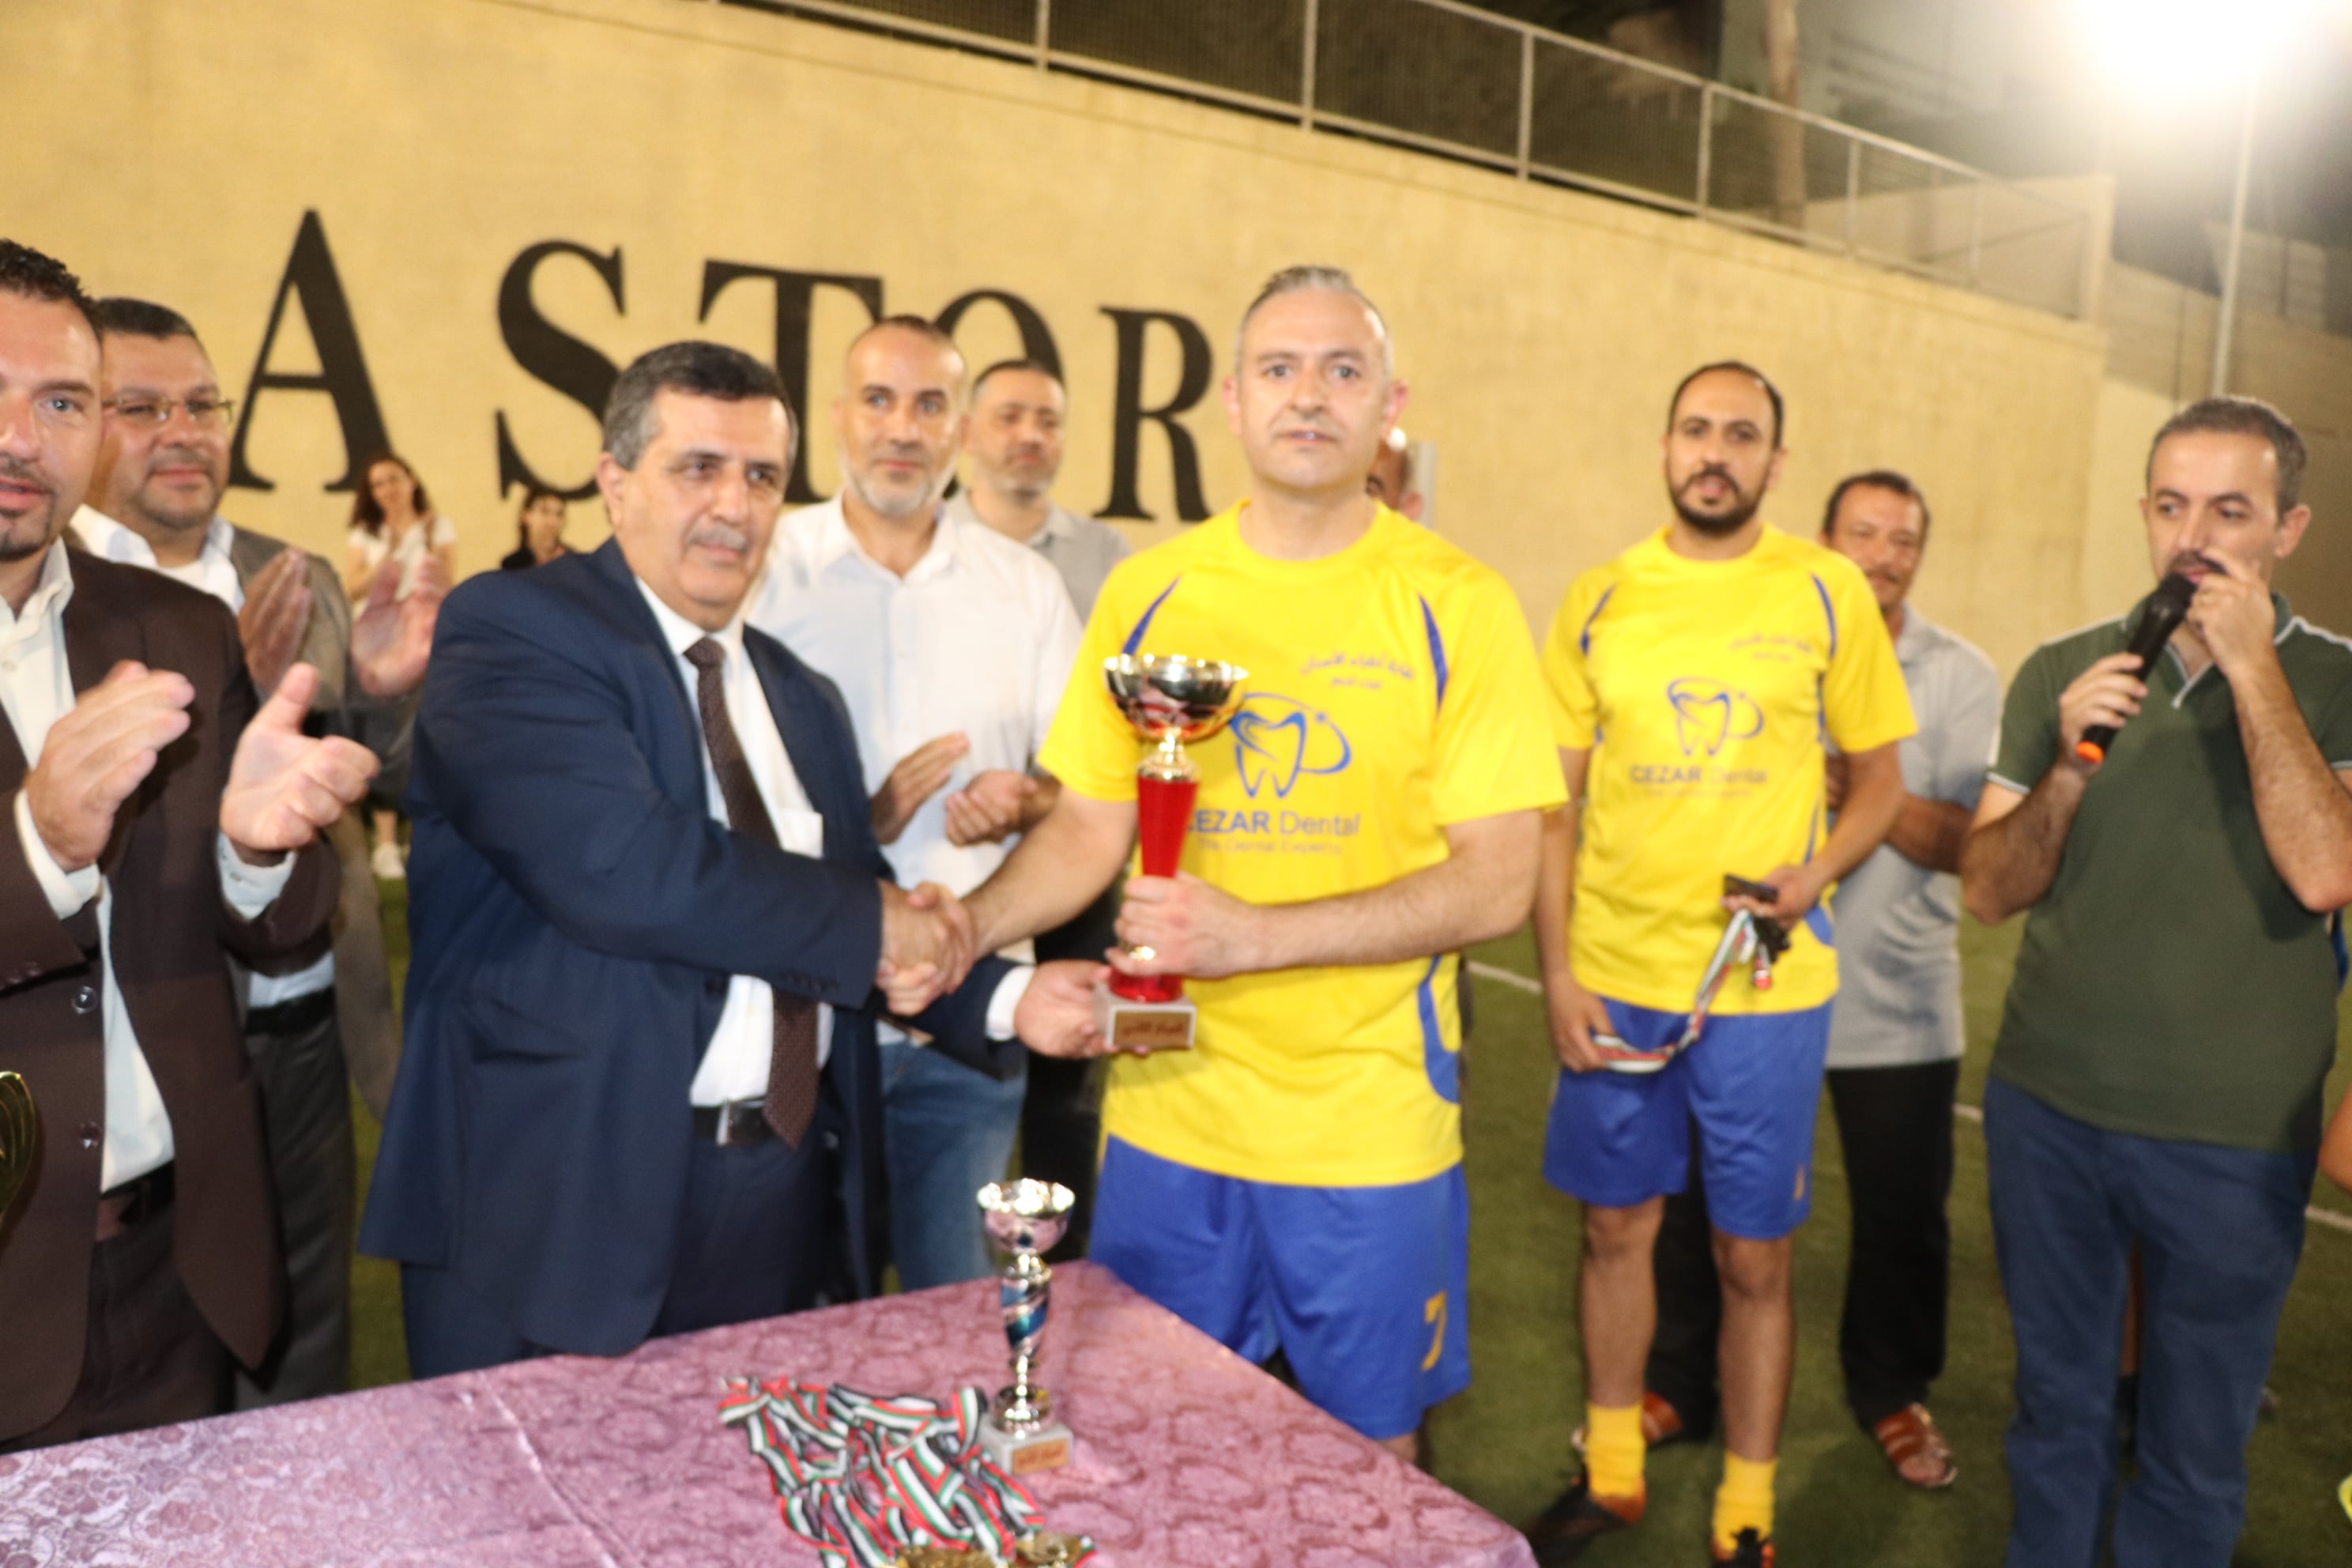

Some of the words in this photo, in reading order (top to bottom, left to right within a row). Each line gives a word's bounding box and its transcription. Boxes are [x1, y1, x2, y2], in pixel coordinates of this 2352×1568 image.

[1189, 808, 1272, 835] EZAR
[1279, 808, 1362, 837] Dental
[1421, 1290, 1447, 1372] 7
